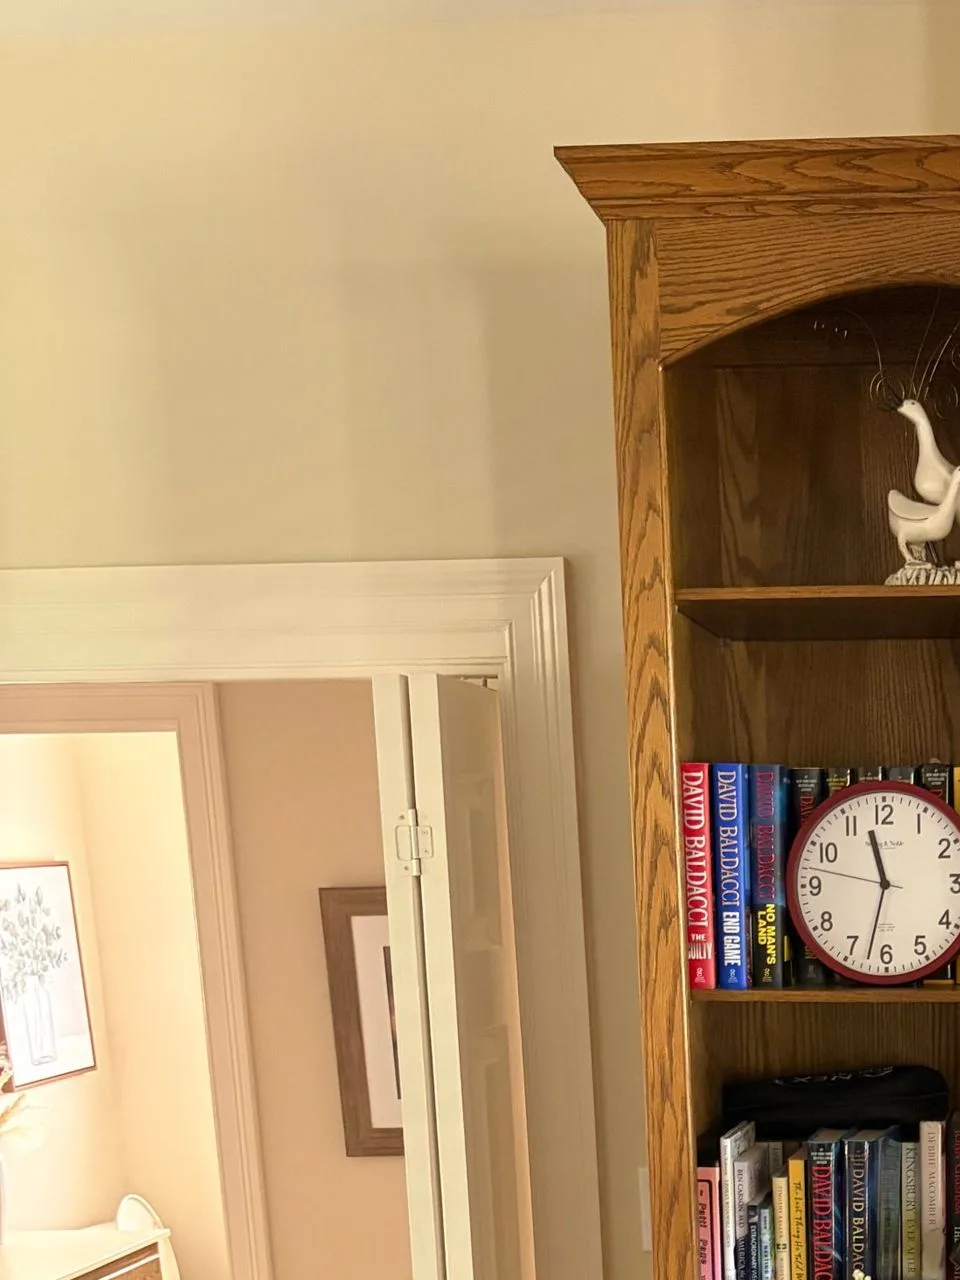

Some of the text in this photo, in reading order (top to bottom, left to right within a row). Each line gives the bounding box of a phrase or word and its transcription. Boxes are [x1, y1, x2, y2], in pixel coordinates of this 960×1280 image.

[875, 804, 894, 825] 12
[916, 813, 921, 834] 1
[756, 771, 776, 899] DAVID BALDACCI
[846, 815, 857, 836] 11
[682, 771, 709, 927] DAVID BALDACCI
[819, 842, 838, 863] 10
[938, 838, 951, 859] 2
[717, 771, 741, 966] DAVID BALDACCI END GAME
[809, 876, 821, 896] 9
[757, 911, 767, 946] LAND
[820, 911, 833, 931] 8
[938, 909, 952, 930] 4
[766, 904, 776, 965] NO MAN'S
[846, 936, 859, 956] 7
[880, 944, 893, 964] 6
[914, 936, 927, 955] 5
[905, 1147, 917, 1214] KINGSBURY
[927, 1132, 937, 1225] DEBBIE MACOMBER
[812, 1166, 832, 1216] DAVID
[852, 1168, 865, 1213] DAVID
[793, 1216, 803, 1239] Thing
[795, 1240, 802, 1251] He
[796, 1253, 804, 1269] Told
